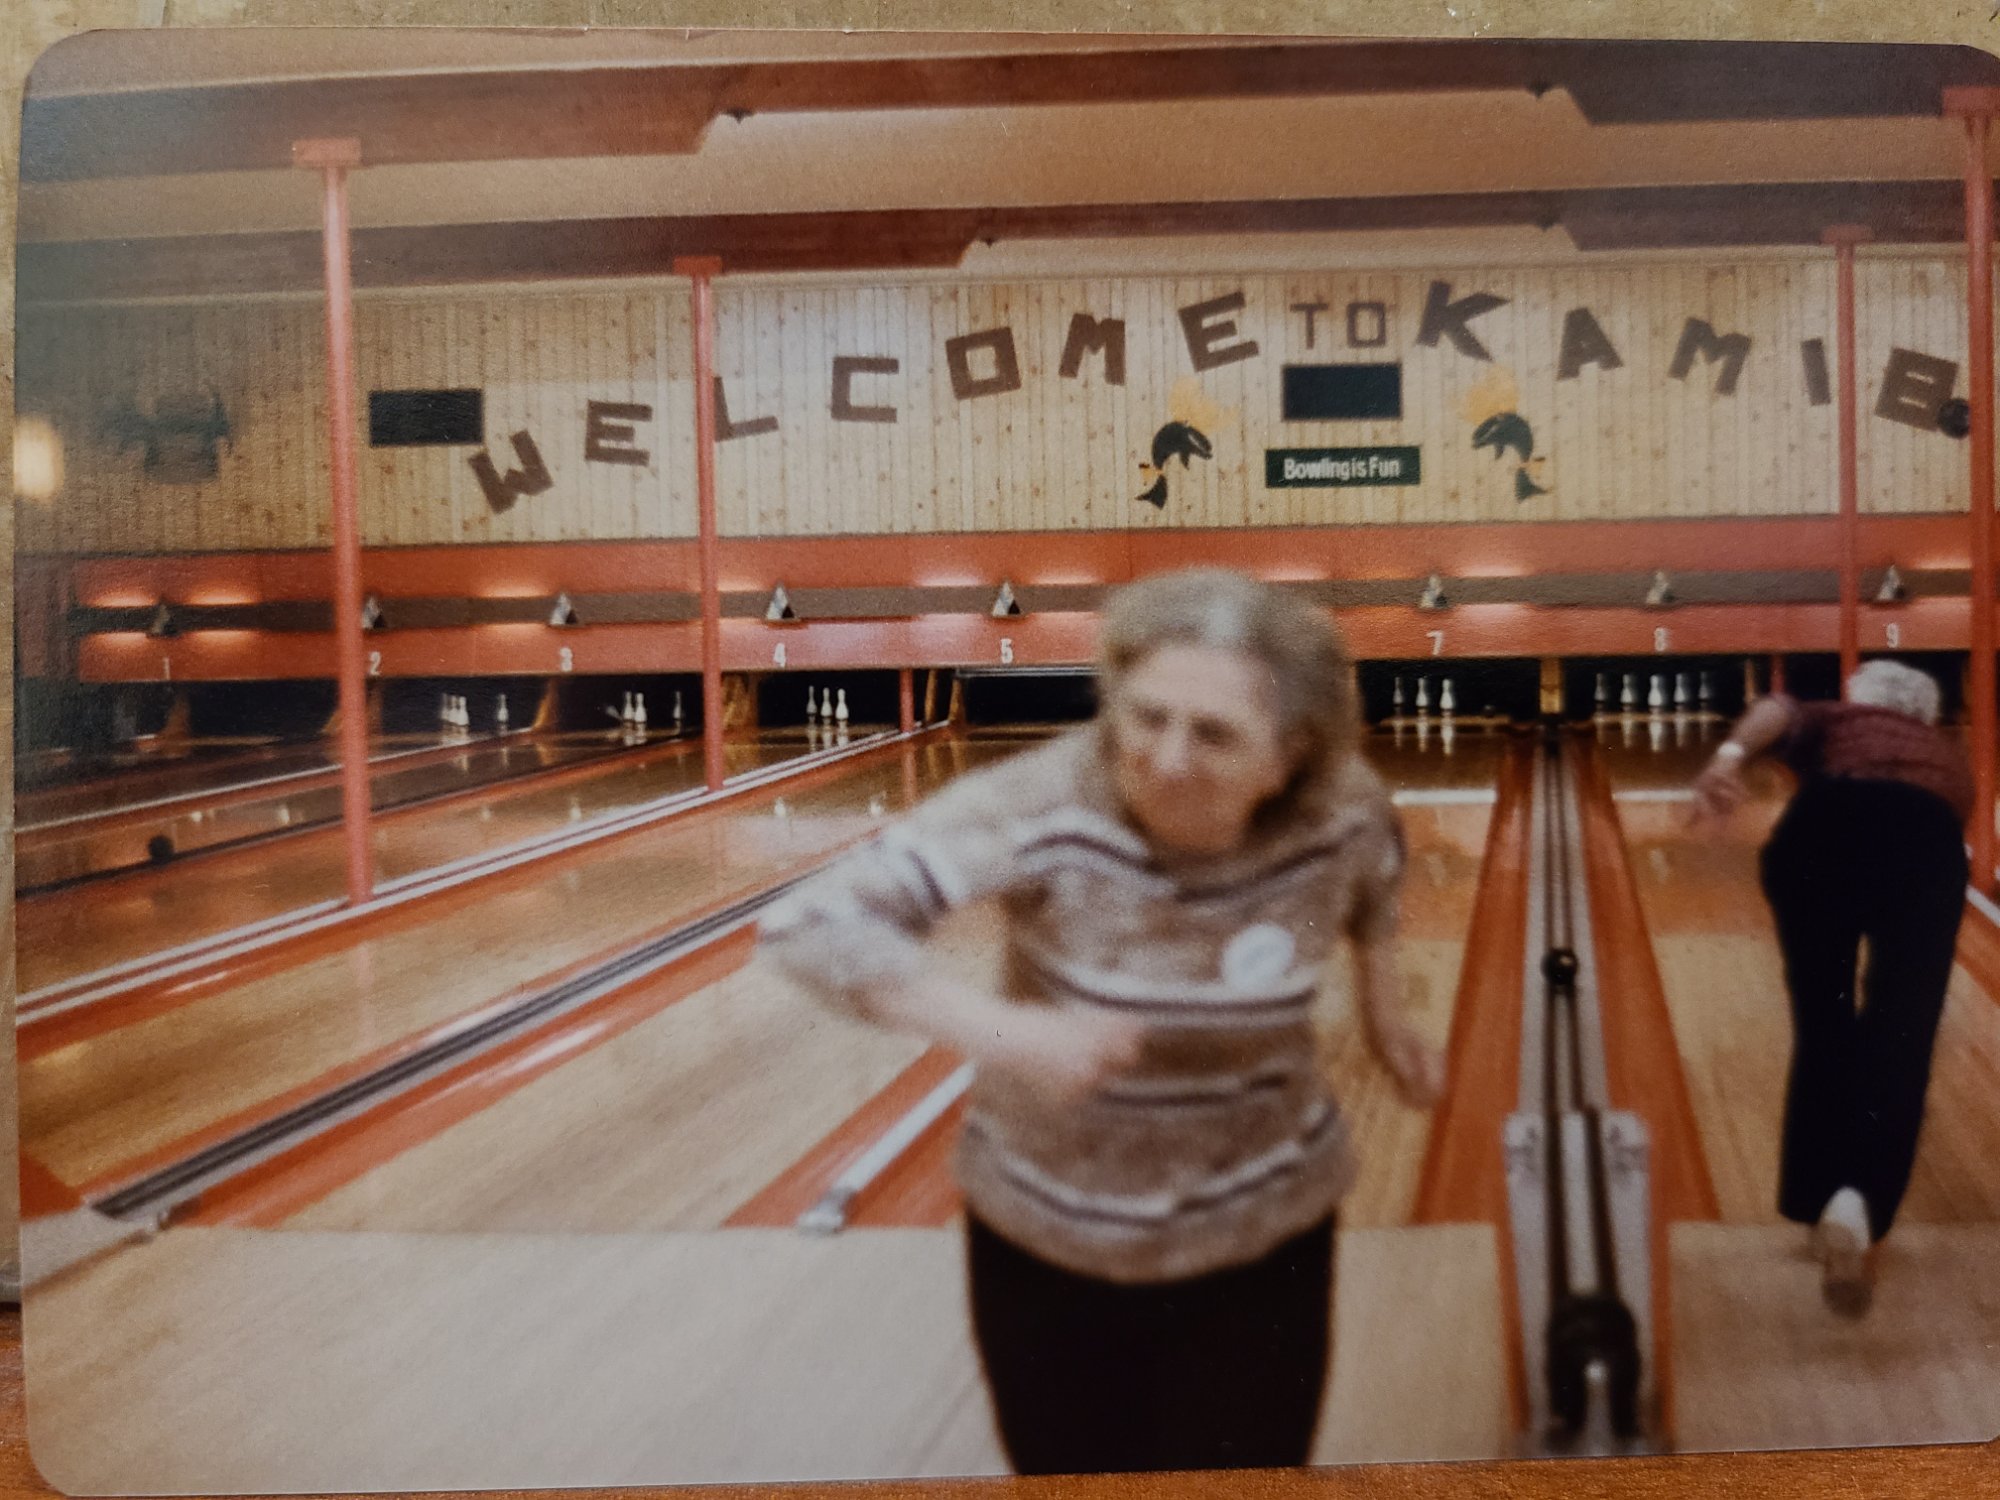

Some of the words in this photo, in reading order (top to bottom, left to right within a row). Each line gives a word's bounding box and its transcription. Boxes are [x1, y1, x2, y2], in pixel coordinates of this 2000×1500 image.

[467, 291, 1260, 514] WELCOME
[1290, 302, 1387, 349] TO
[1284, 457, 1350, 481] Bowling
[1351, 457, 1367, 478] is
[1368, 455, 1400, 478] Fun
[1425, 630, 1443, 656] 7
[1654, 627, 1668, 651] 8
[1886, 622, 1899, 649] 9
[369, 651, 381, 676] 2
[560, 647, 573, 672] 3
[773, 642, 786, 668] 4
[1000, 638, 1013, 664] 5
